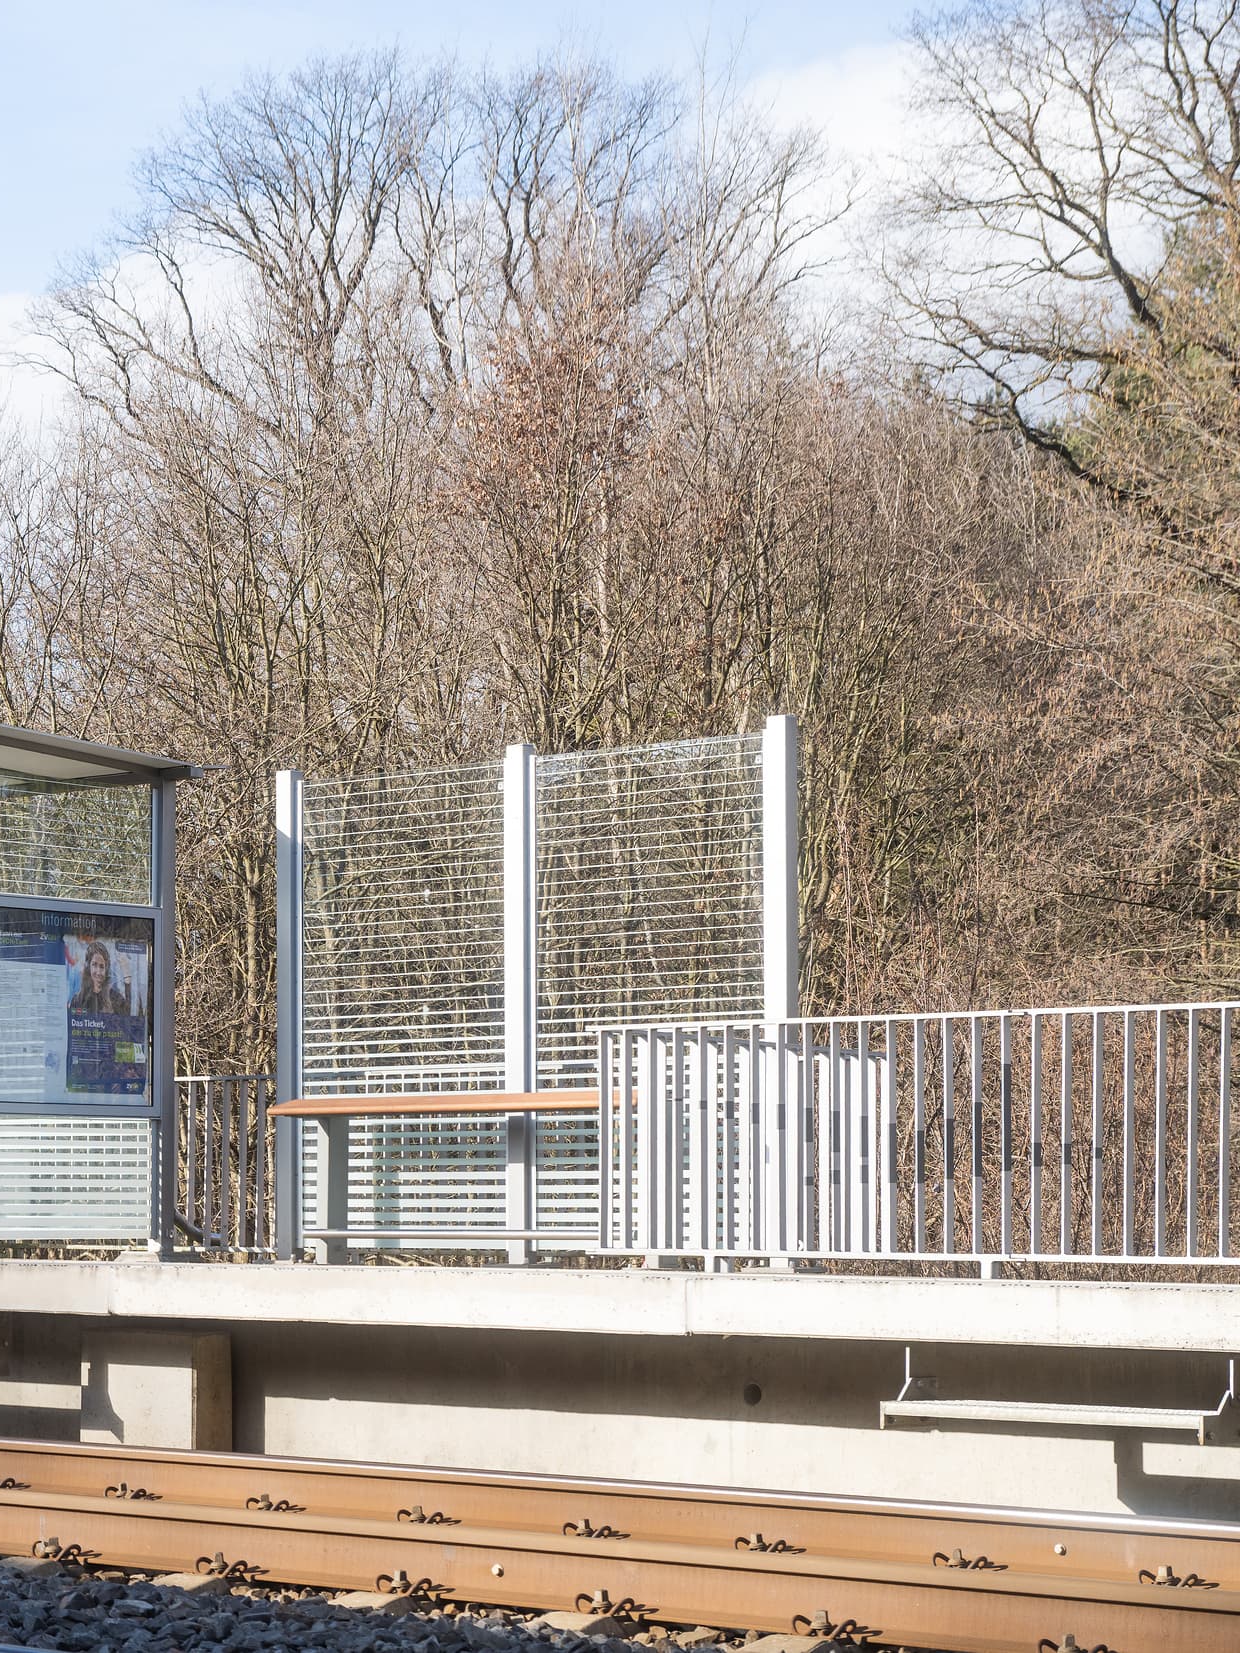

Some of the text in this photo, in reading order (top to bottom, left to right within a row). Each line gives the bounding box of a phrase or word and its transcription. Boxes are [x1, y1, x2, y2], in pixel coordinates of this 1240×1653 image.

[41, 911, 97, 929] Information
[72, 1019, 105, 1029] Das Ticket,
